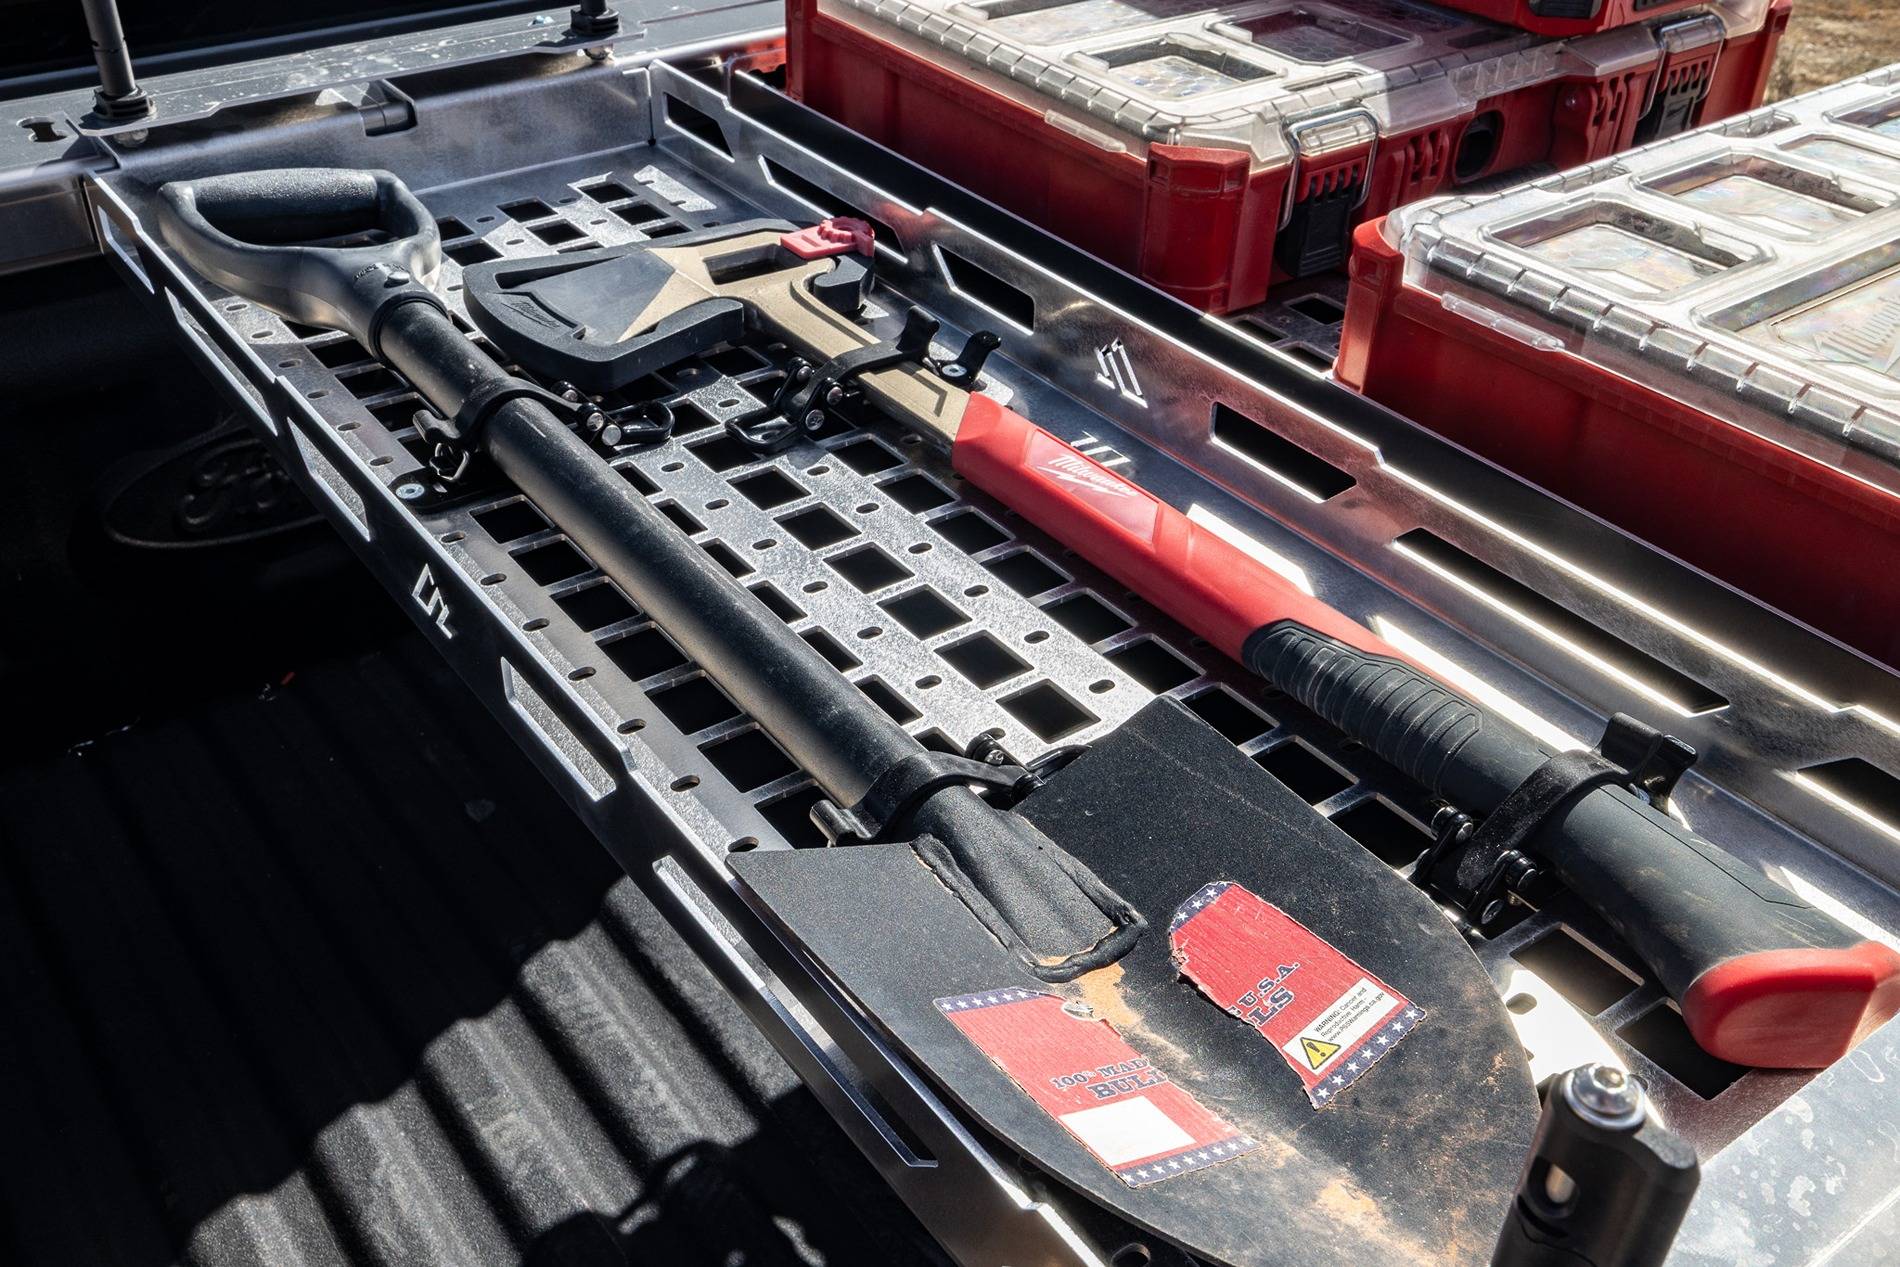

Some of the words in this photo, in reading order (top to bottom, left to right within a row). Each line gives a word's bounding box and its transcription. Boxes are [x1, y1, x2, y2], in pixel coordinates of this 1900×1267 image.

[1237, 961, 1301, 1008] U.S.A.
[1314, 1010, 1342, 1033] WARNING:
[1340, 995, 1359, 1012] Cancer
[1357, 987, 1367, 999] and
[1320, 1011, 1353, 1037] Reproductive
[1351, 999, 1366, 1013] Harm
[1049, 1070, 1096, 1089] 100%
